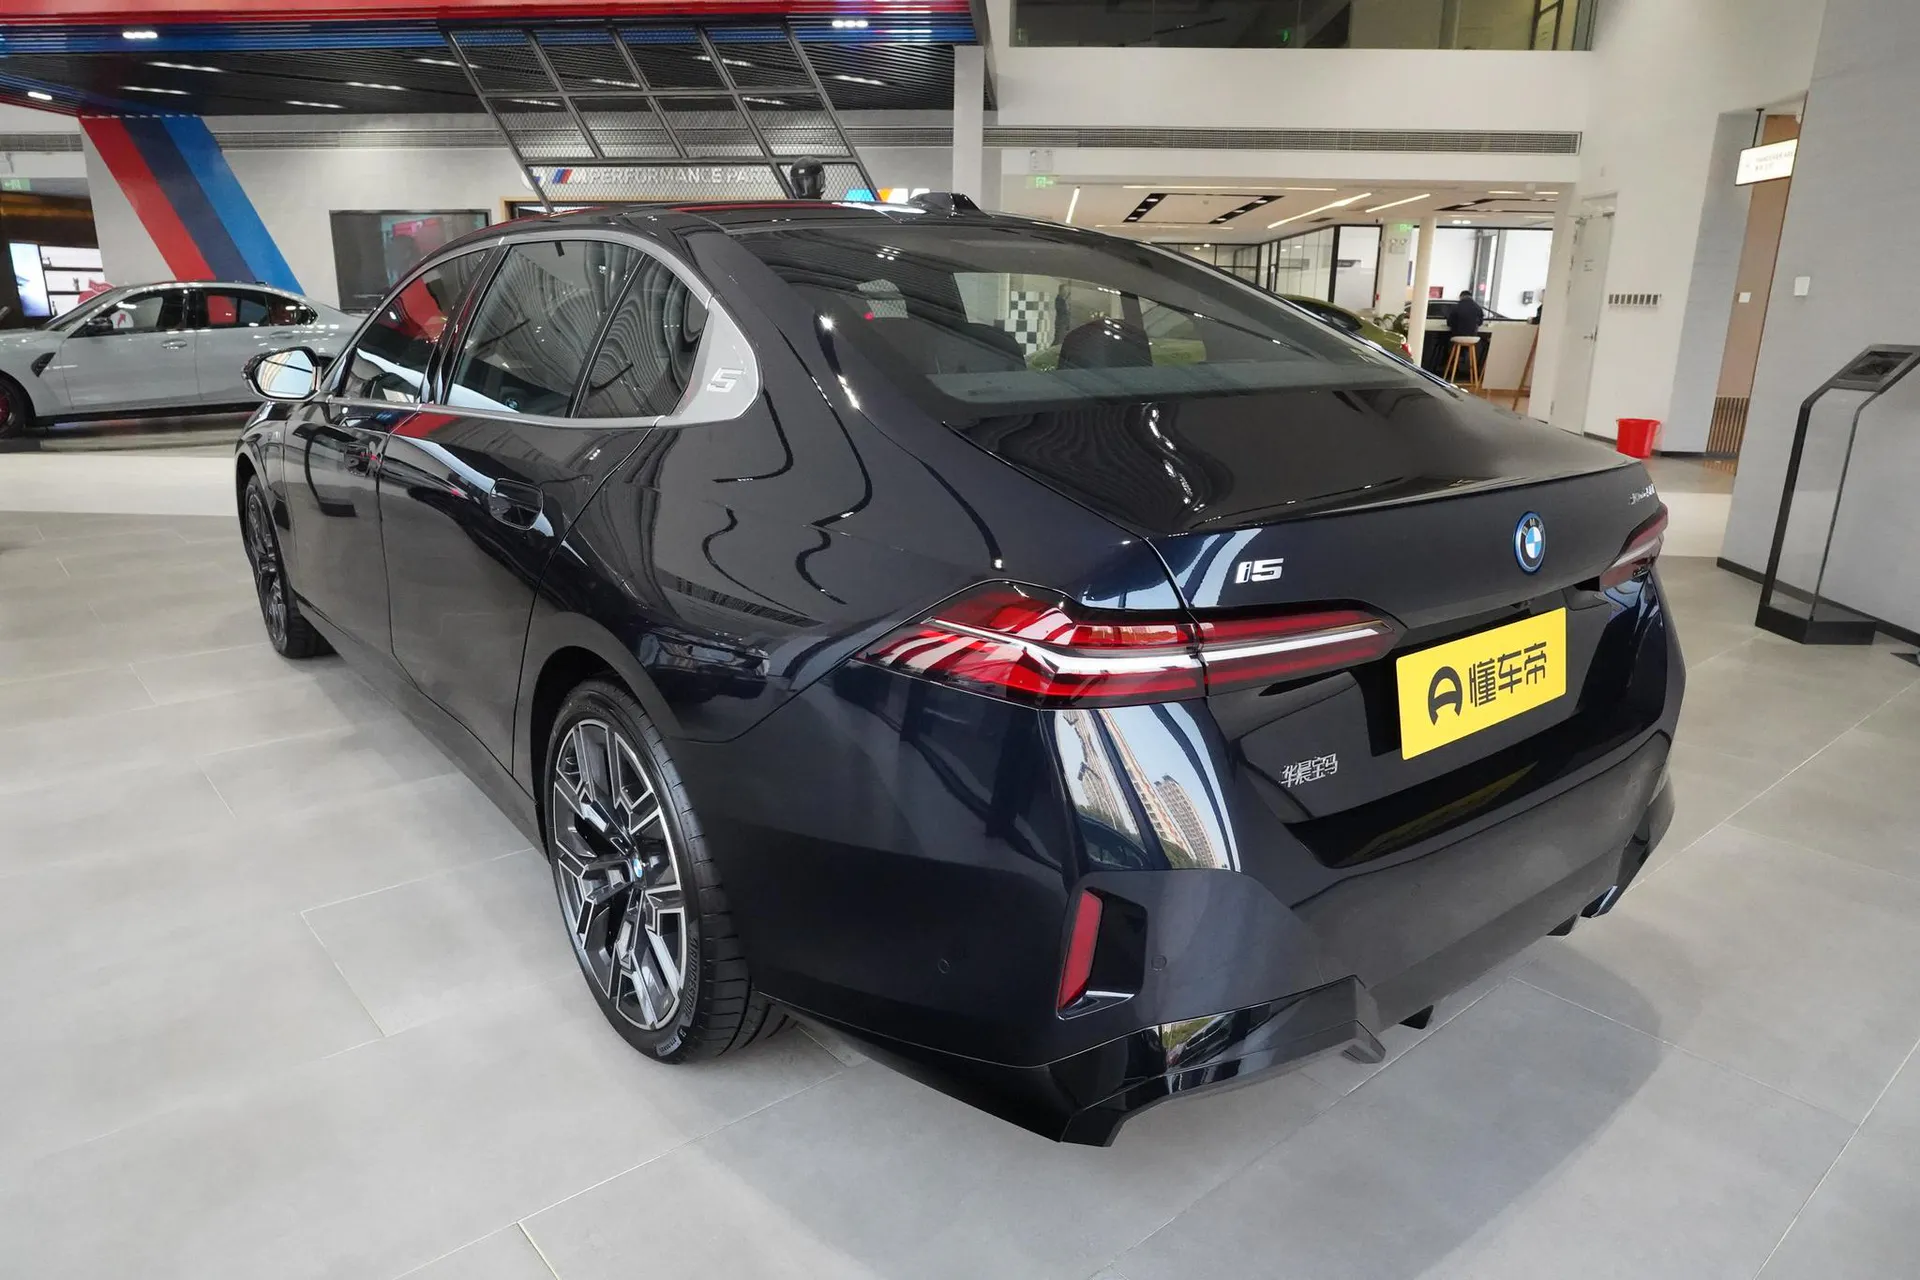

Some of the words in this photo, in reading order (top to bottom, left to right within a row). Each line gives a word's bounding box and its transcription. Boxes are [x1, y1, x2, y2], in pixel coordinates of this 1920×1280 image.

[588, 168, 723, 184] PERFORMANCE
[1235, 557, 1284, 584] i5
[1469, 641, 1547, 707] 懂车帝
[1280, 753, 1339, 788] 华晨宝马
